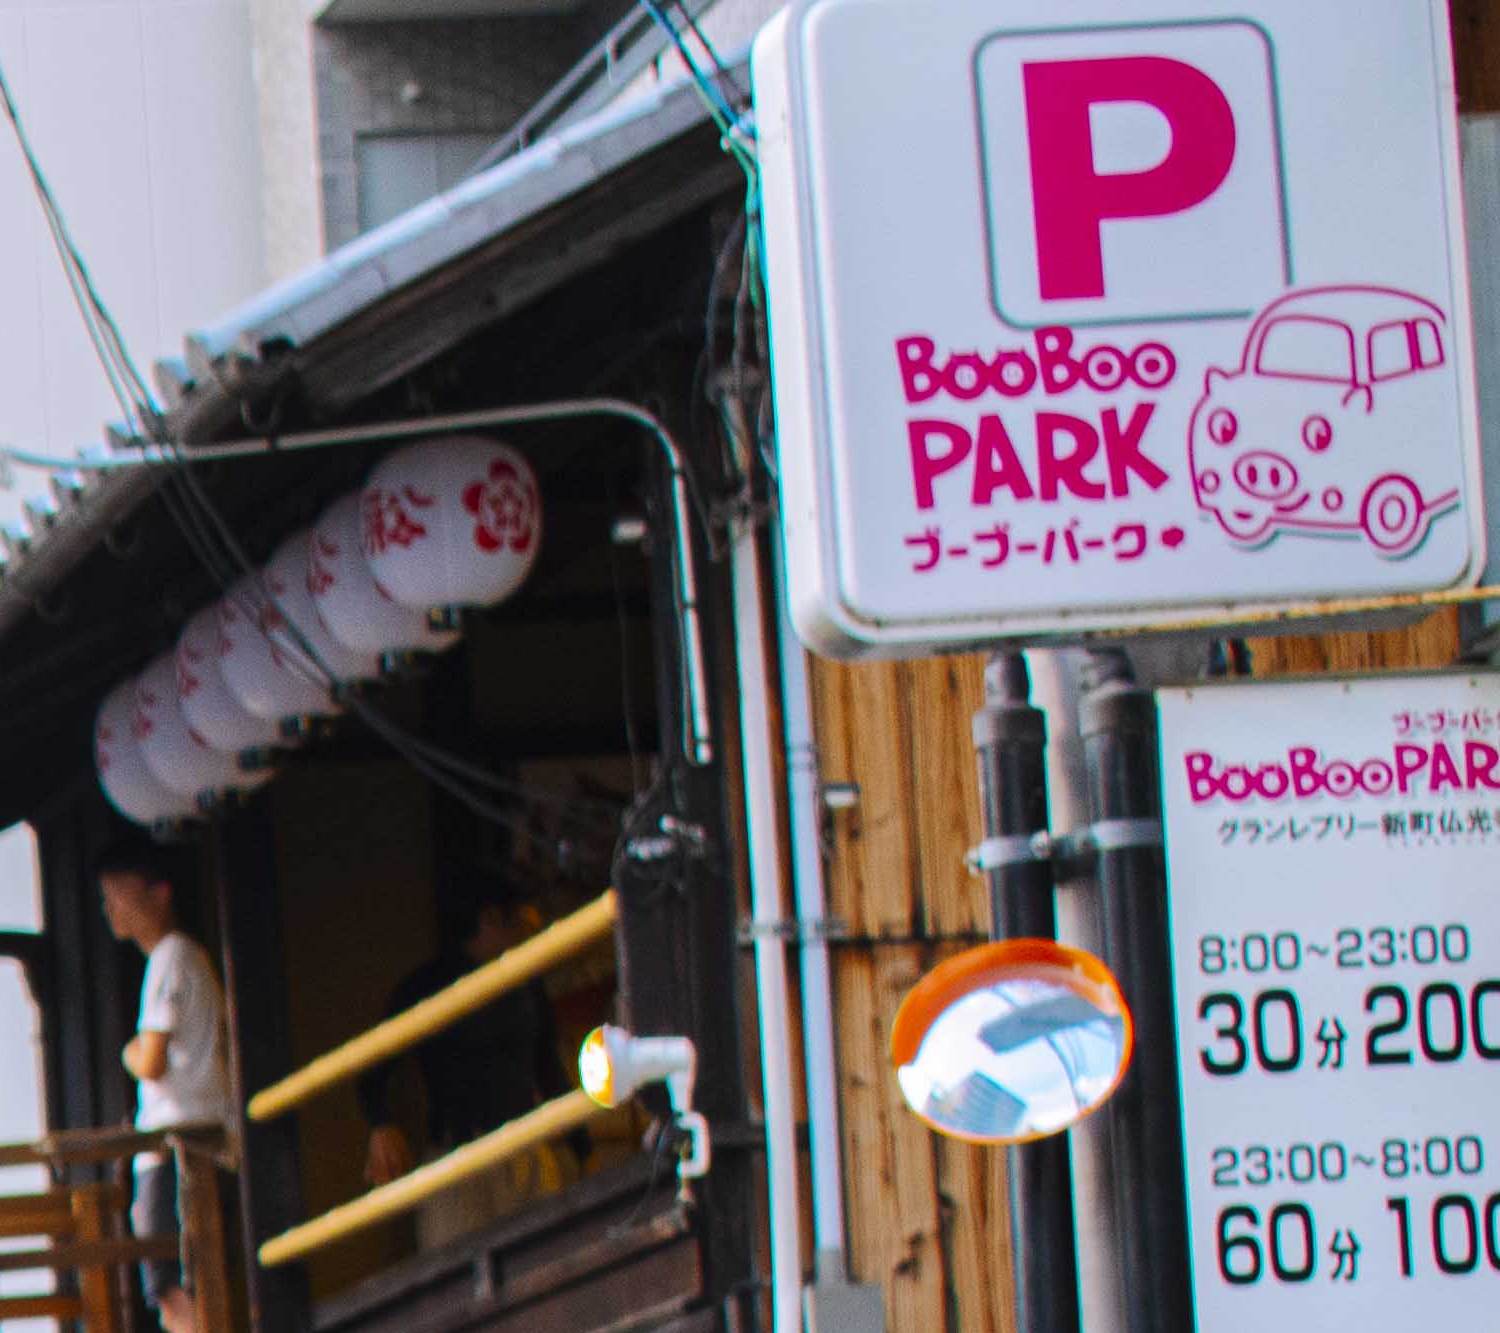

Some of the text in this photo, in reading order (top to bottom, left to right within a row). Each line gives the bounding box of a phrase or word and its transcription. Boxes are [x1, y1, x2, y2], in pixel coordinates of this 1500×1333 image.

[1022, 56, 1236, 301] P
[908, 402, 1168, 508] PARK
[1390, 707, 1500, 735] ブーブーパー
